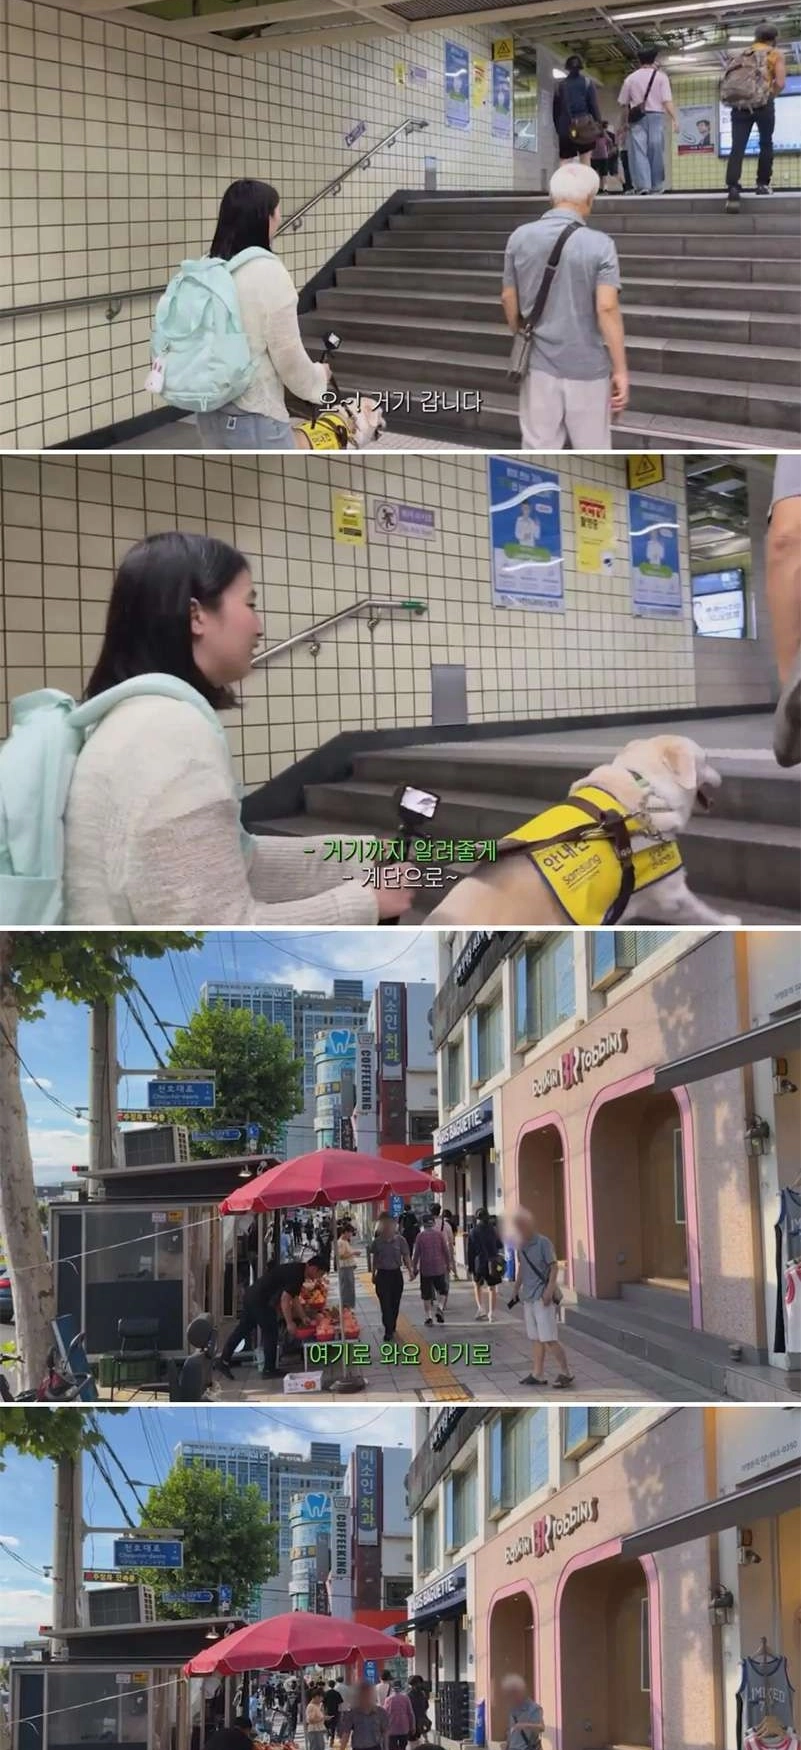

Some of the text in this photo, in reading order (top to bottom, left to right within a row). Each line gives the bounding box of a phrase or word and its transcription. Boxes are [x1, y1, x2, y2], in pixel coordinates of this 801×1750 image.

[158, 1084, 194, 1094] 천호대로
[361, 1050, 373, 1112] COFFEEKING
[449, 1108, 483, 1140] BAGUETTE
[124, 1543, 161, 1552] 천호대로
[336, 1514, 347, 1575] COFFEEKING
